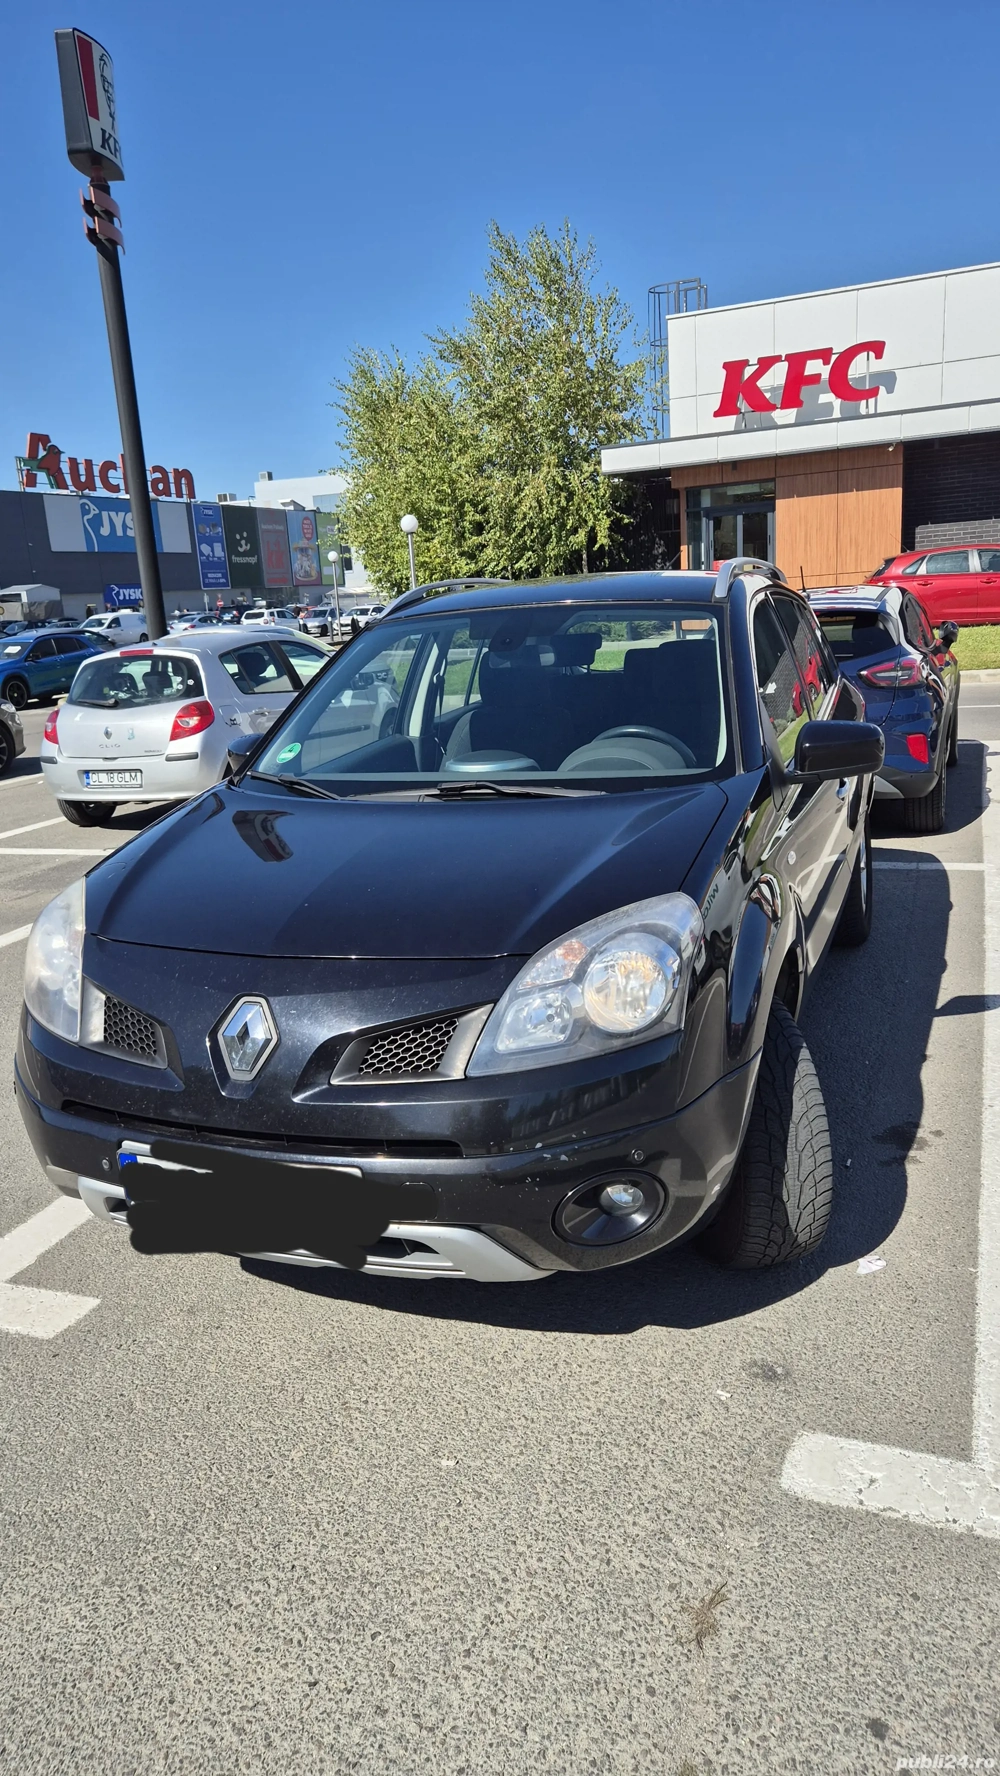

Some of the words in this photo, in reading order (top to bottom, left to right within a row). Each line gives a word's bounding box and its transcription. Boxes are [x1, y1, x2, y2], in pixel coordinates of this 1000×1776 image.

[100, 125, 124, 168] KF
[713, 340, 886, 418] KFC
[100, 511, 135, 537] JYS
[231, 554, 257, 565] fressnapf
[118, 588, 143, 600] JYSK
[91, 772, 103, 783] CL
[106, 772, 115, 783] 18
[117, 771, 138, 783] GLM
